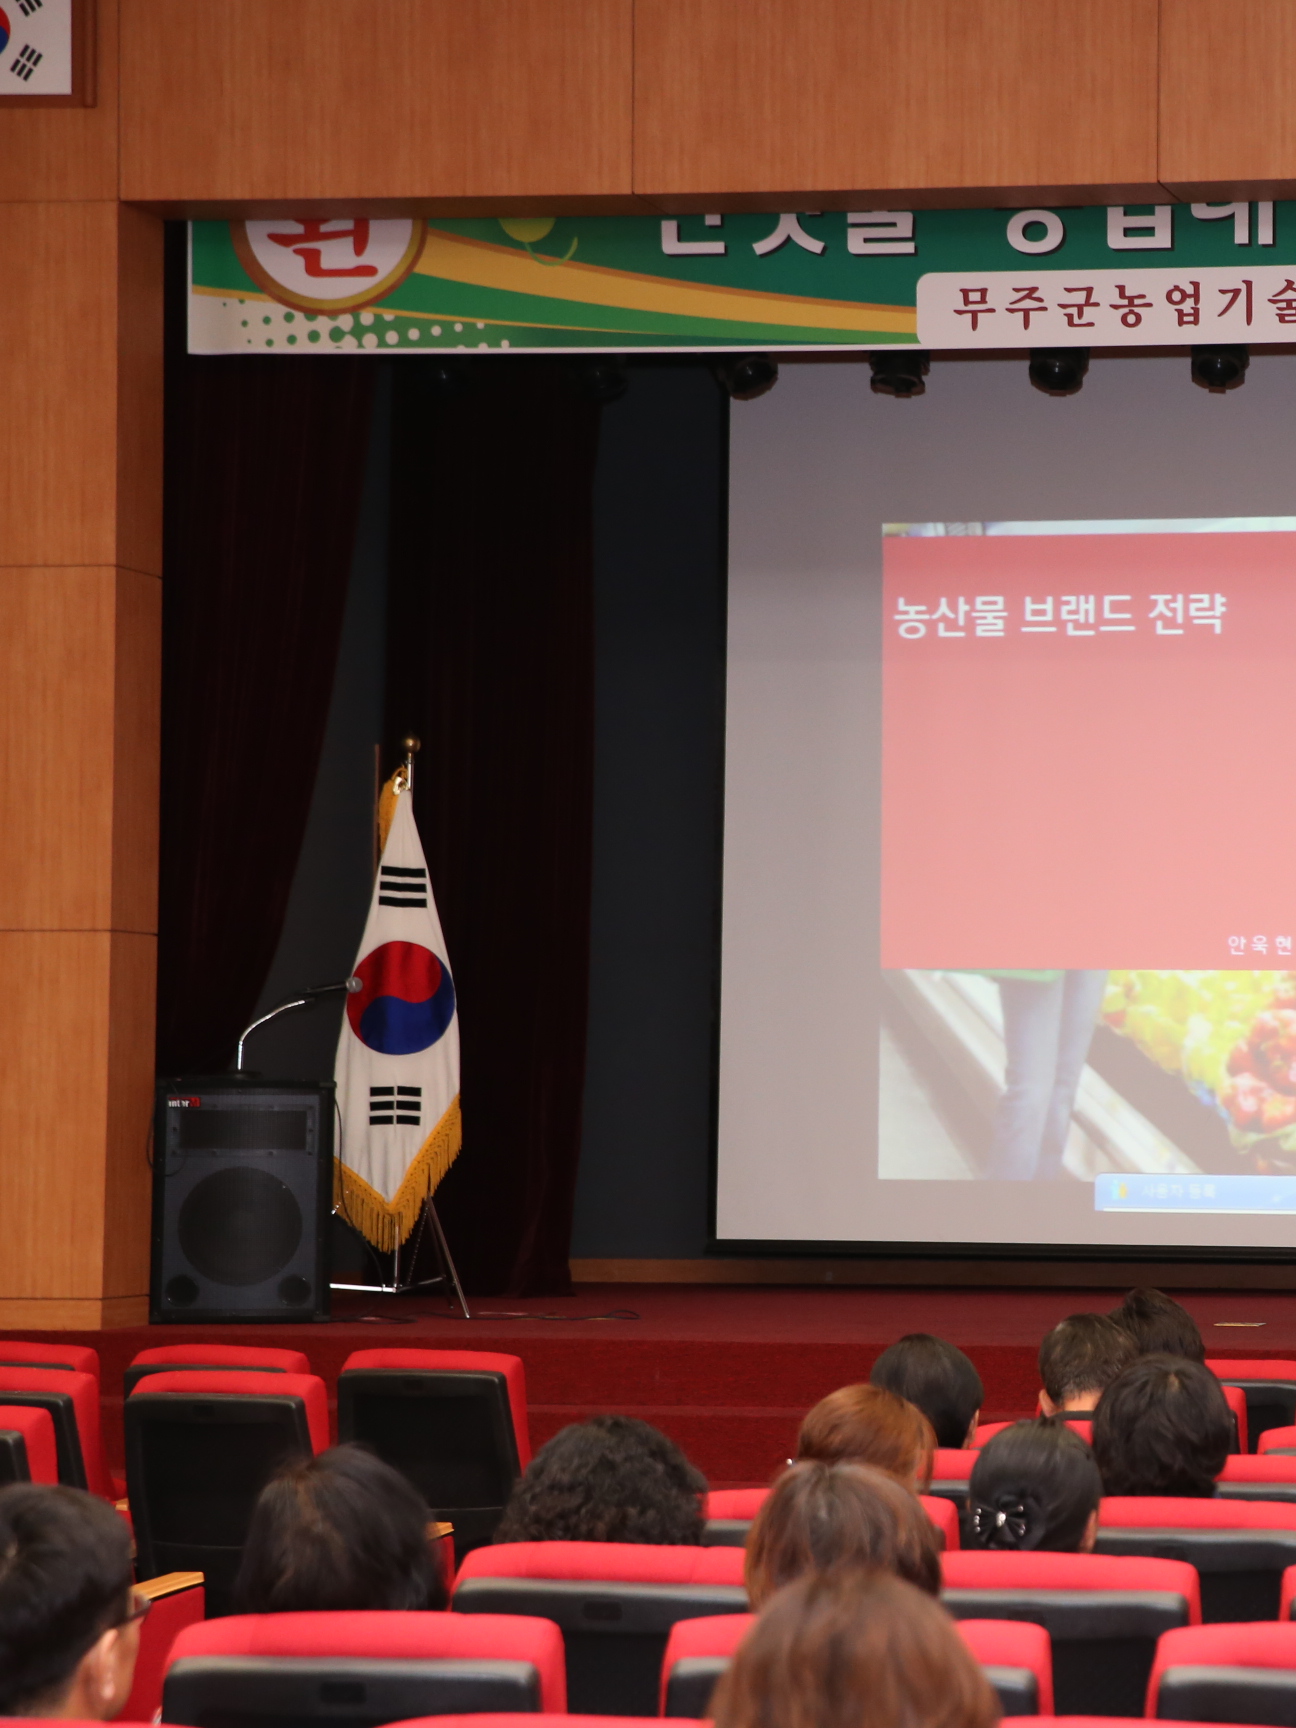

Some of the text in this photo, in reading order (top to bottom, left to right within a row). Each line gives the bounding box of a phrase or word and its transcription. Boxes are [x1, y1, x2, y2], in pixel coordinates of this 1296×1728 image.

[894, 592, 1227, 639] 농산물 브랜드 전략
